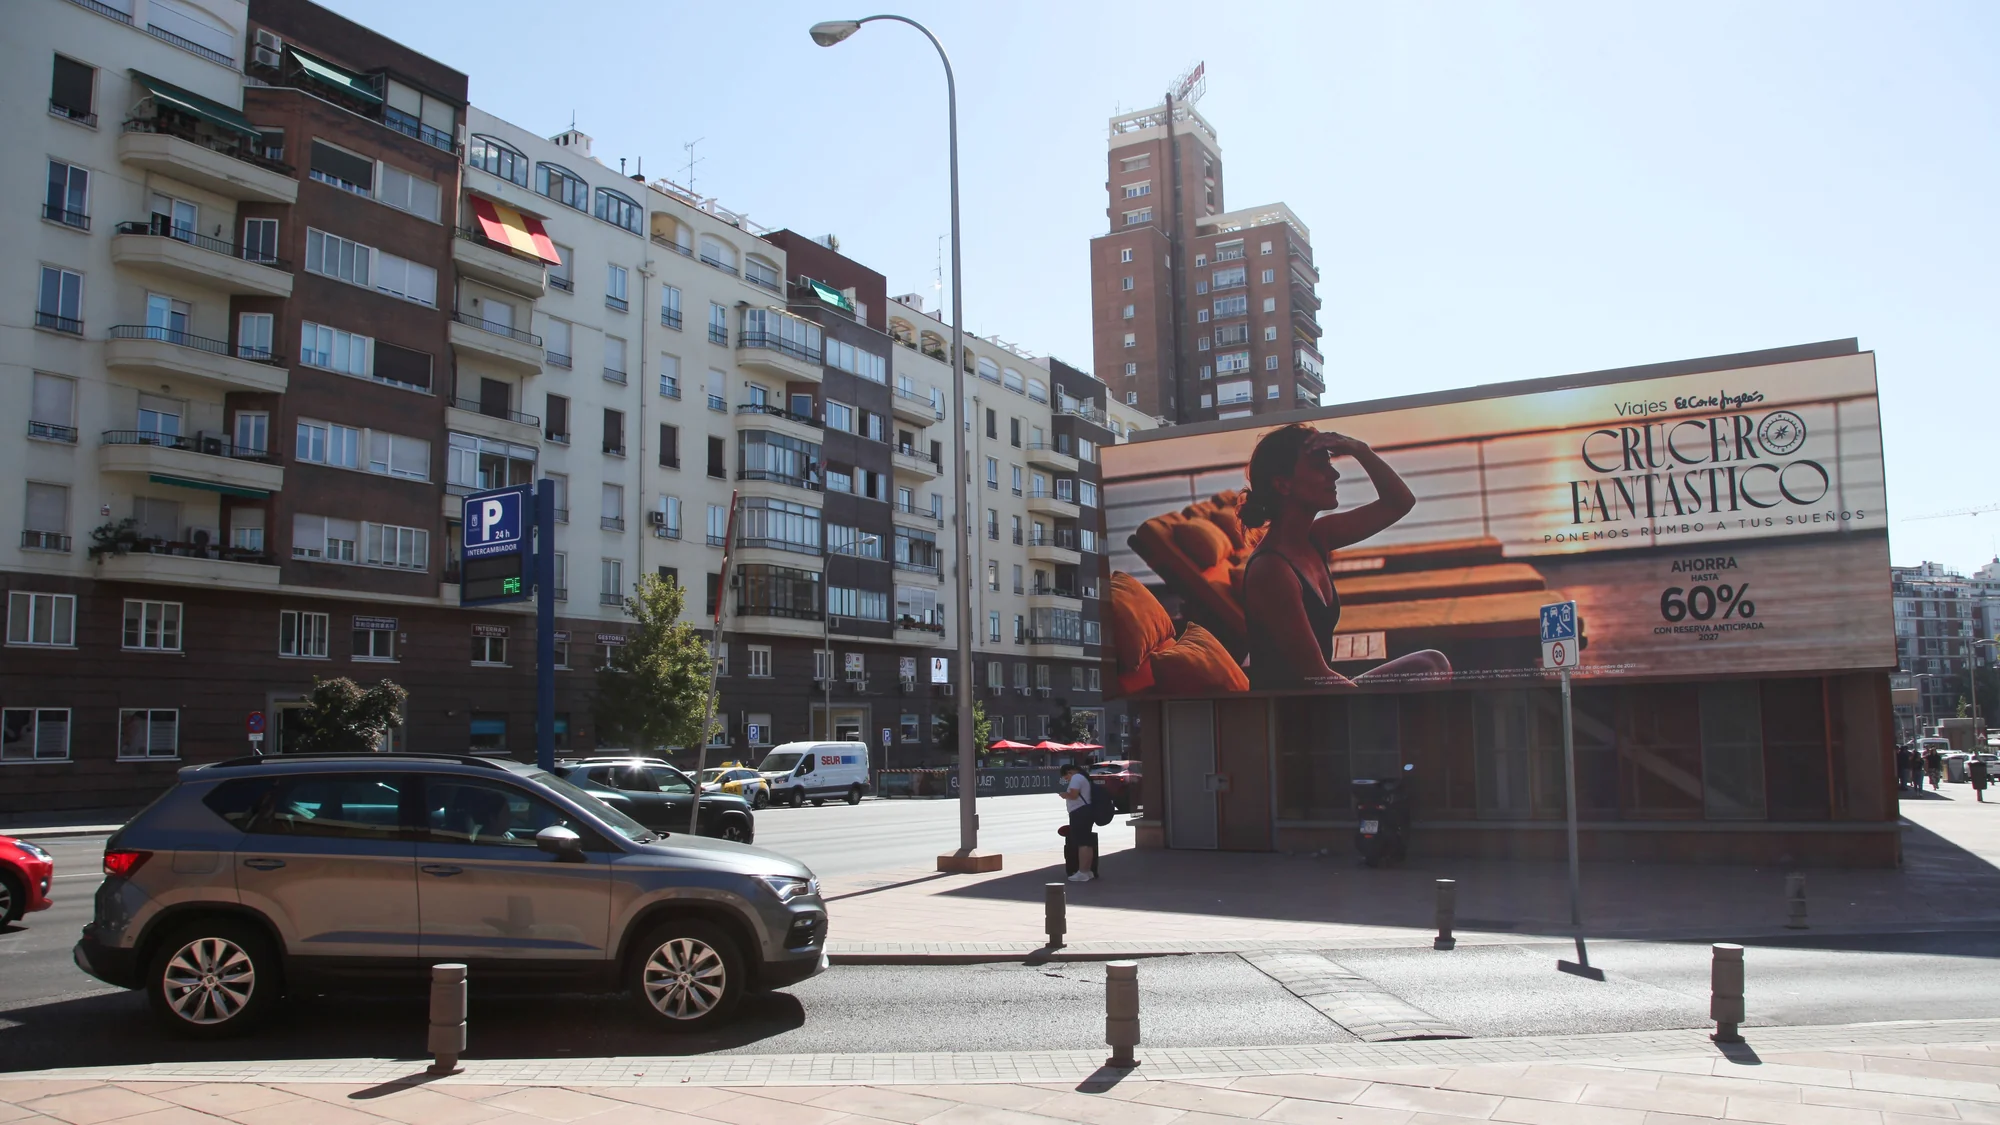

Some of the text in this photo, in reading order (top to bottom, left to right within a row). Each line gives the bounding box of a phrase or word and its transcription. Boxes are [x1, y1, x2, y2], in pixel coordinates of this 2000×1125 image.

[1614, 390, 1764, 417] Viajes El Corte Inglés
[1567, 459, 1829, 525] FANTÁSTICO
[482, 499, 503, 541] P
[1544, 509, 1866, 544] PONEMOS RUMBO A TUS SUEÑOS
[495, 529, 510, 540] 24 h
[467, 543, 518, 557] INTERCAMBIADOR
[1671, 556, 1738, 573] AHORRA
[1691, 573, 1719, 582] HASTA
[1660, 583, 1755, 622] 60%
[475, 625, 506, 633] INTERNAS
[1654, 622, 1765, 634] CON RESERVA ANTICIPADA
[597, 634, 625, 642] GESTORIA
[1698, 633, 1719, 641] 2027
[1554, 650, 1563, 658] 20
[750, 726, 757, 737] P
[884, 730, 890, 739] P
[821, 755, 841, 766] SEUR
[1004, 776, 1019, 789] 900
[1021, 775, 1030, 788] 20
[1031, 774, 1041, 788] 20
[1042, 775, 1051, 788] 11
